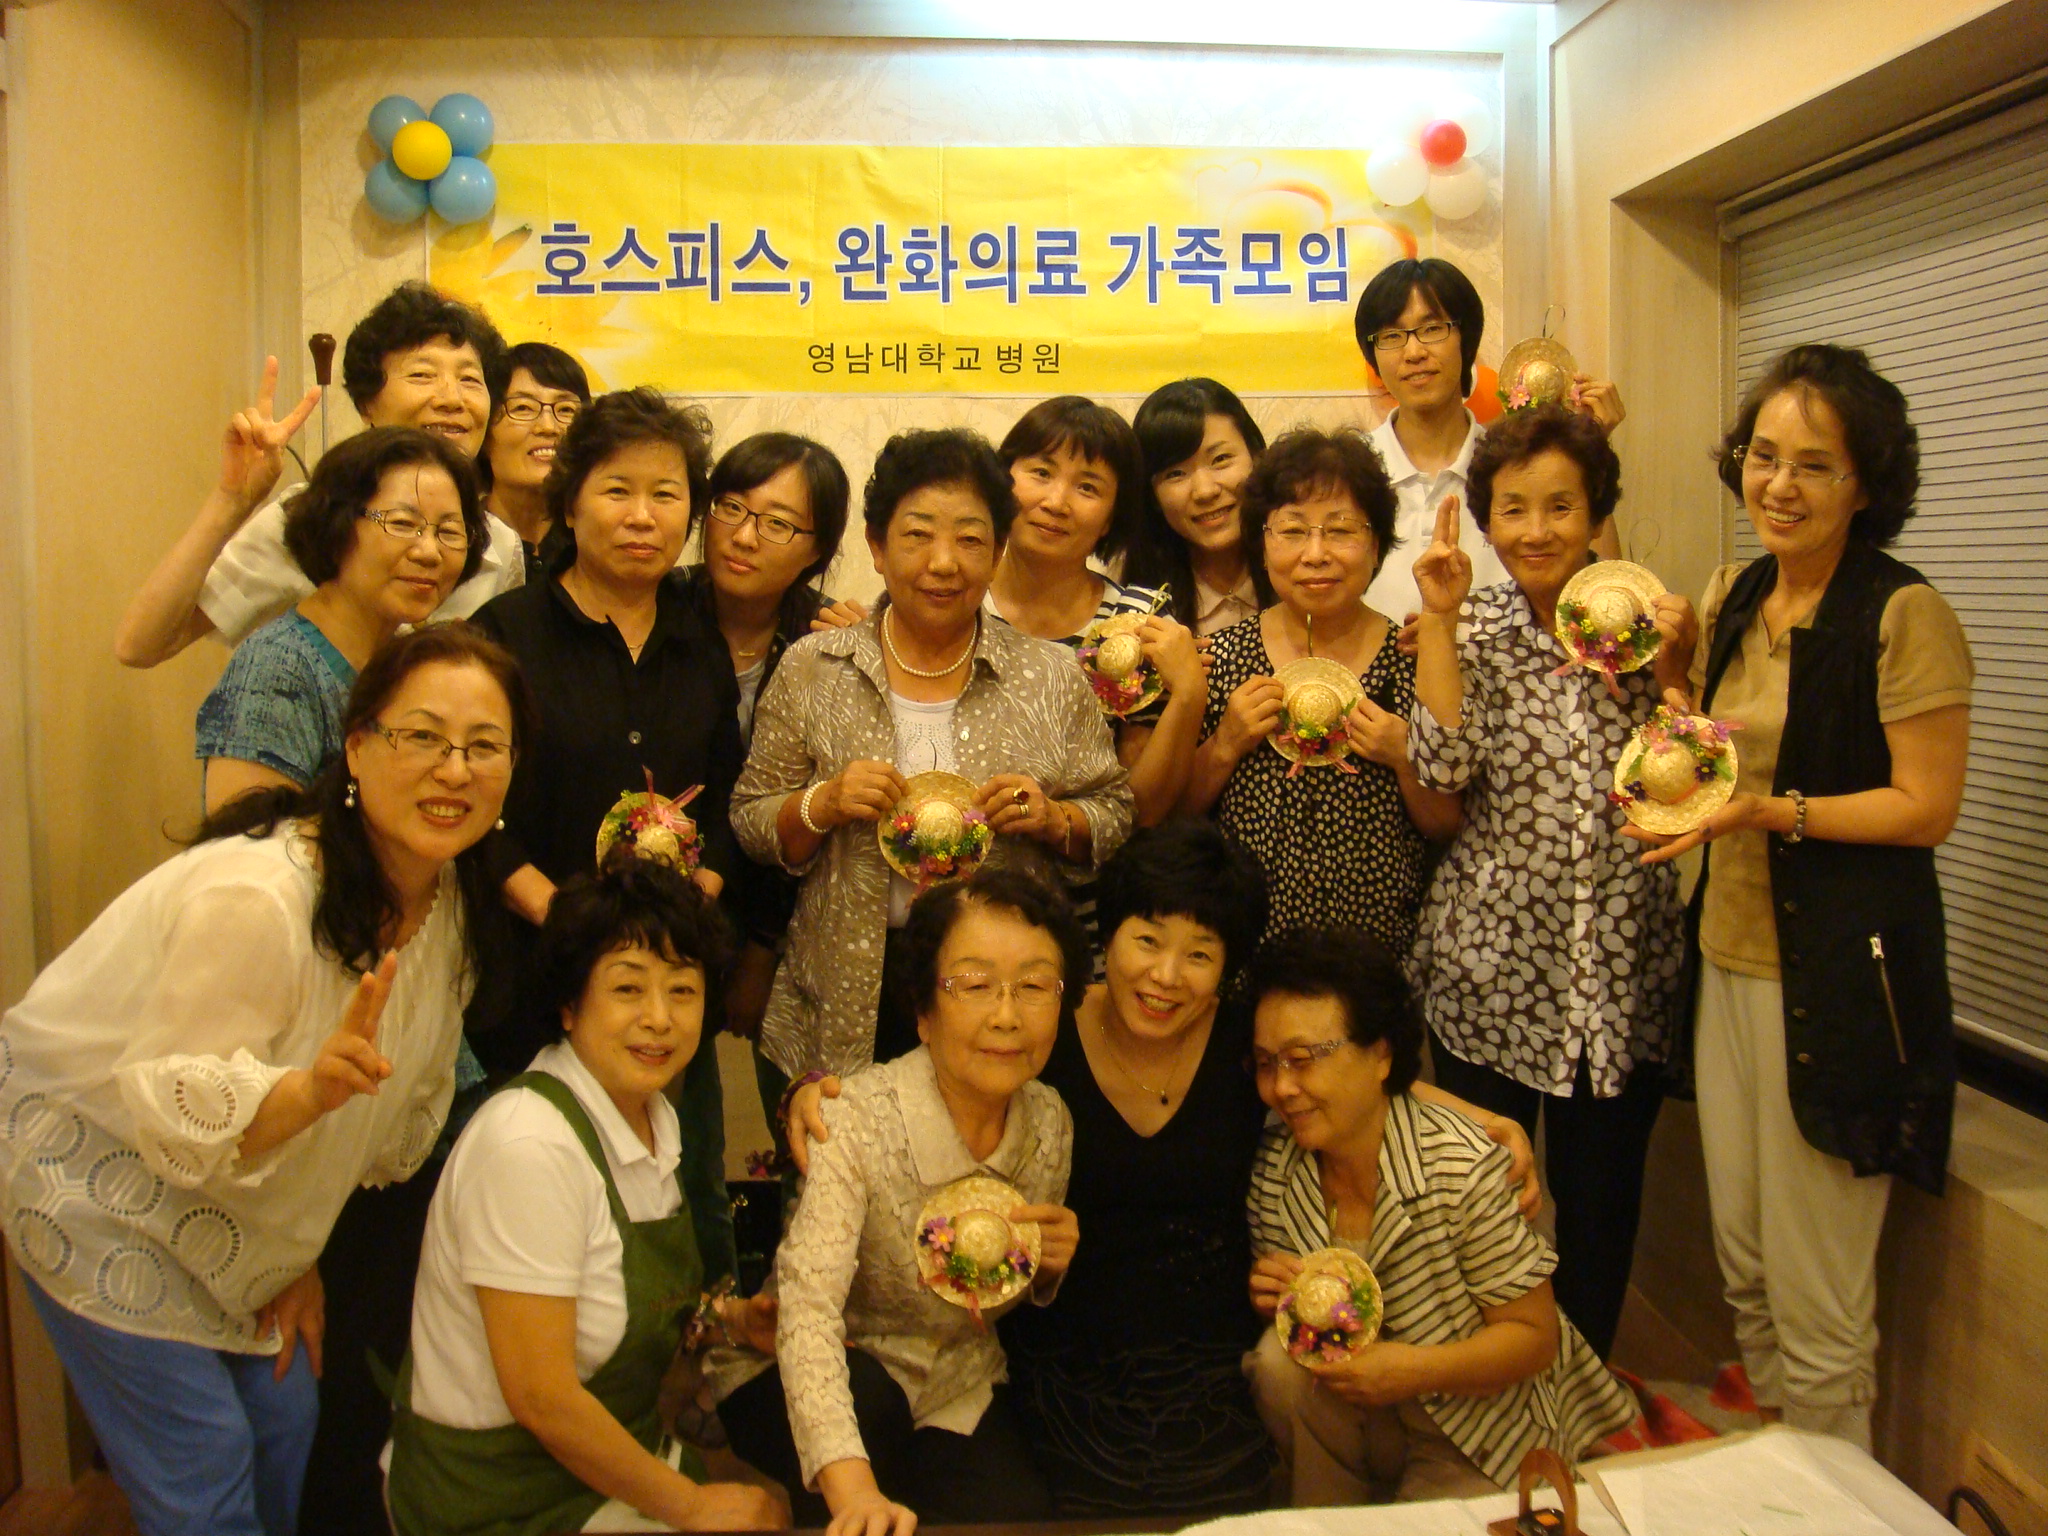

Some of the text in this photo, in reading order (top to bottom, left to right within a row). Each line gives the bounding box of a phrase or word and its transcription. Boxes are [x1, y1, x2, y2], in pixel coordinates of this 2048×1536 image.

[536, 222, 1348, 305] 호스피스, 완화의료 가족모임
[807, 342, 1060, 374] 영남대학교 병원
